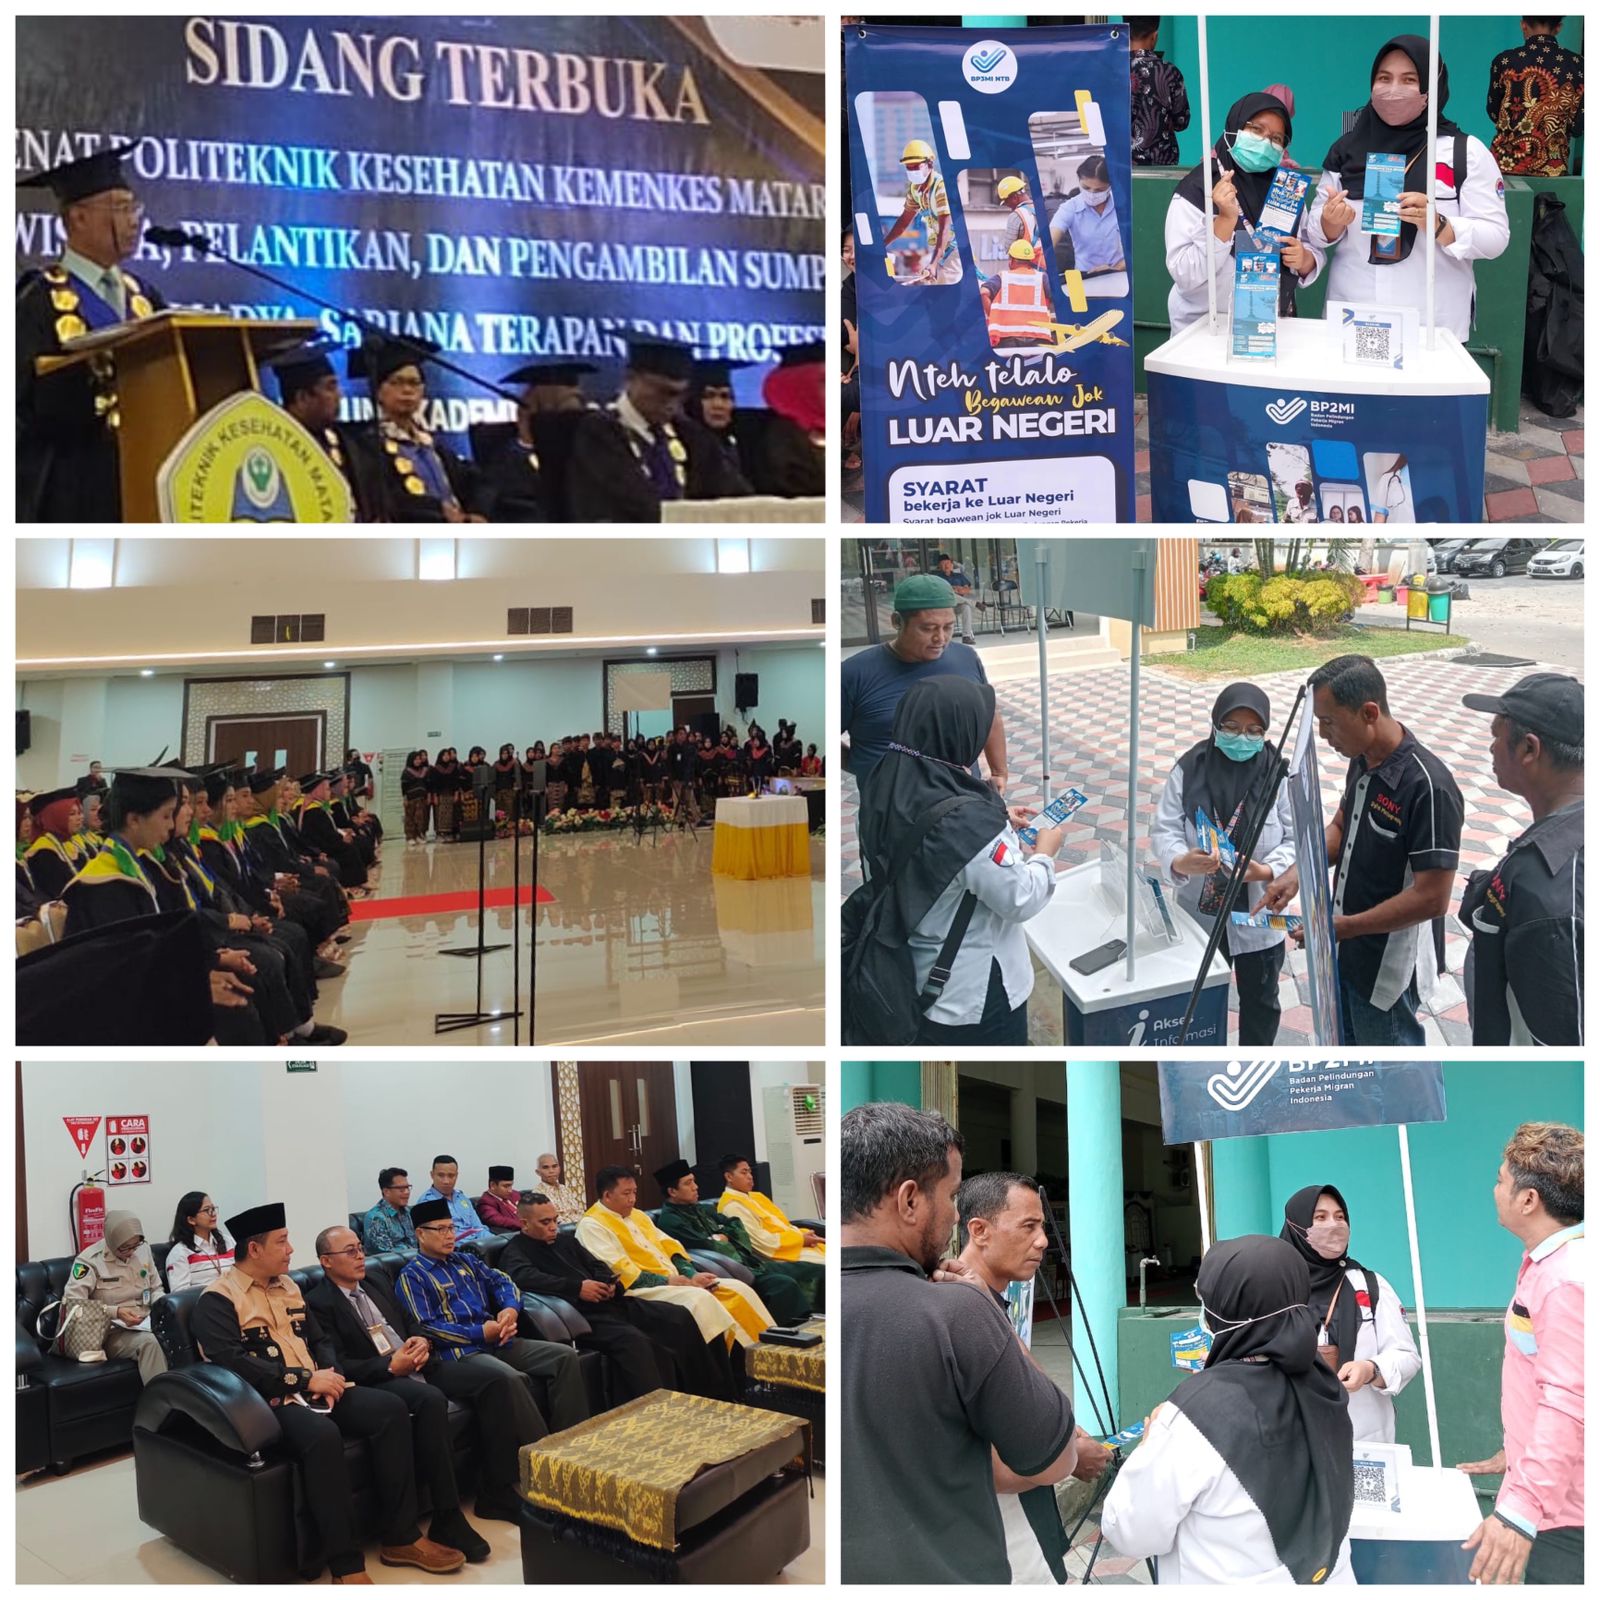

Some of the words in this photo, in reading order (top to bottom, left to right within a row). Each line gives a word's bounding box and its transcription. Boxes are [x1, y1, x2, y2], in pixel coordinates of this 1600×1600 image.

[184, 16, 424, 101] SIDANG
[435, 40, 710, 124] TERBUKA
[347, 150, 545, 202] KESEHATAN
[551, 165, 723, 213] KEMENKES
[726, 178, 825, 219] MATAR
[180, 220, 420, 279] PELANTIKAN,
[426, 233, 501, 276] DAN
[508, 238, 738, 288] PENGAMBILAN
[744, 250, 825, 291] SUMP
[889, 359, 977, 400] Nteh
[985, 355, 1078, 394] telalo
[964, 390, 1063, 416] Begawean
[1072, 383, 1104, 409] Jok
[1310, 400, 1355, 414] BP2MI
[889, 415, 983, 445] LUAR
[992, 407, 1116, 440] NEGERI
[217, 417, 312, 465] KESEHATAN
[903, 477, 988, 497] SYARAT
[904, 498, 961, 513] bekerja
[965, 497, 984, 508] ke
[988, 495, 1022, 507] Luar
[1025, 490, 1075, 505] Negeri
[985, 511, 1002, 522] jok
[1004, 511, 1026, 519] Luar
[1028, 508, 1062, 518] Negeri
[1376, 792, 1402, 815] SONY
[1289, 1076, 1316, 1085] Badan
[1318, 1070, 1375, 1081] Pelindungan
[1289, 1085, 1322, 1094] Pekerja
[1324, 1082, 1355, 1092] Migran
[1290, 1094, 1333, 1104] Indonesia
[120, 1118, 145, 1128] CARA
